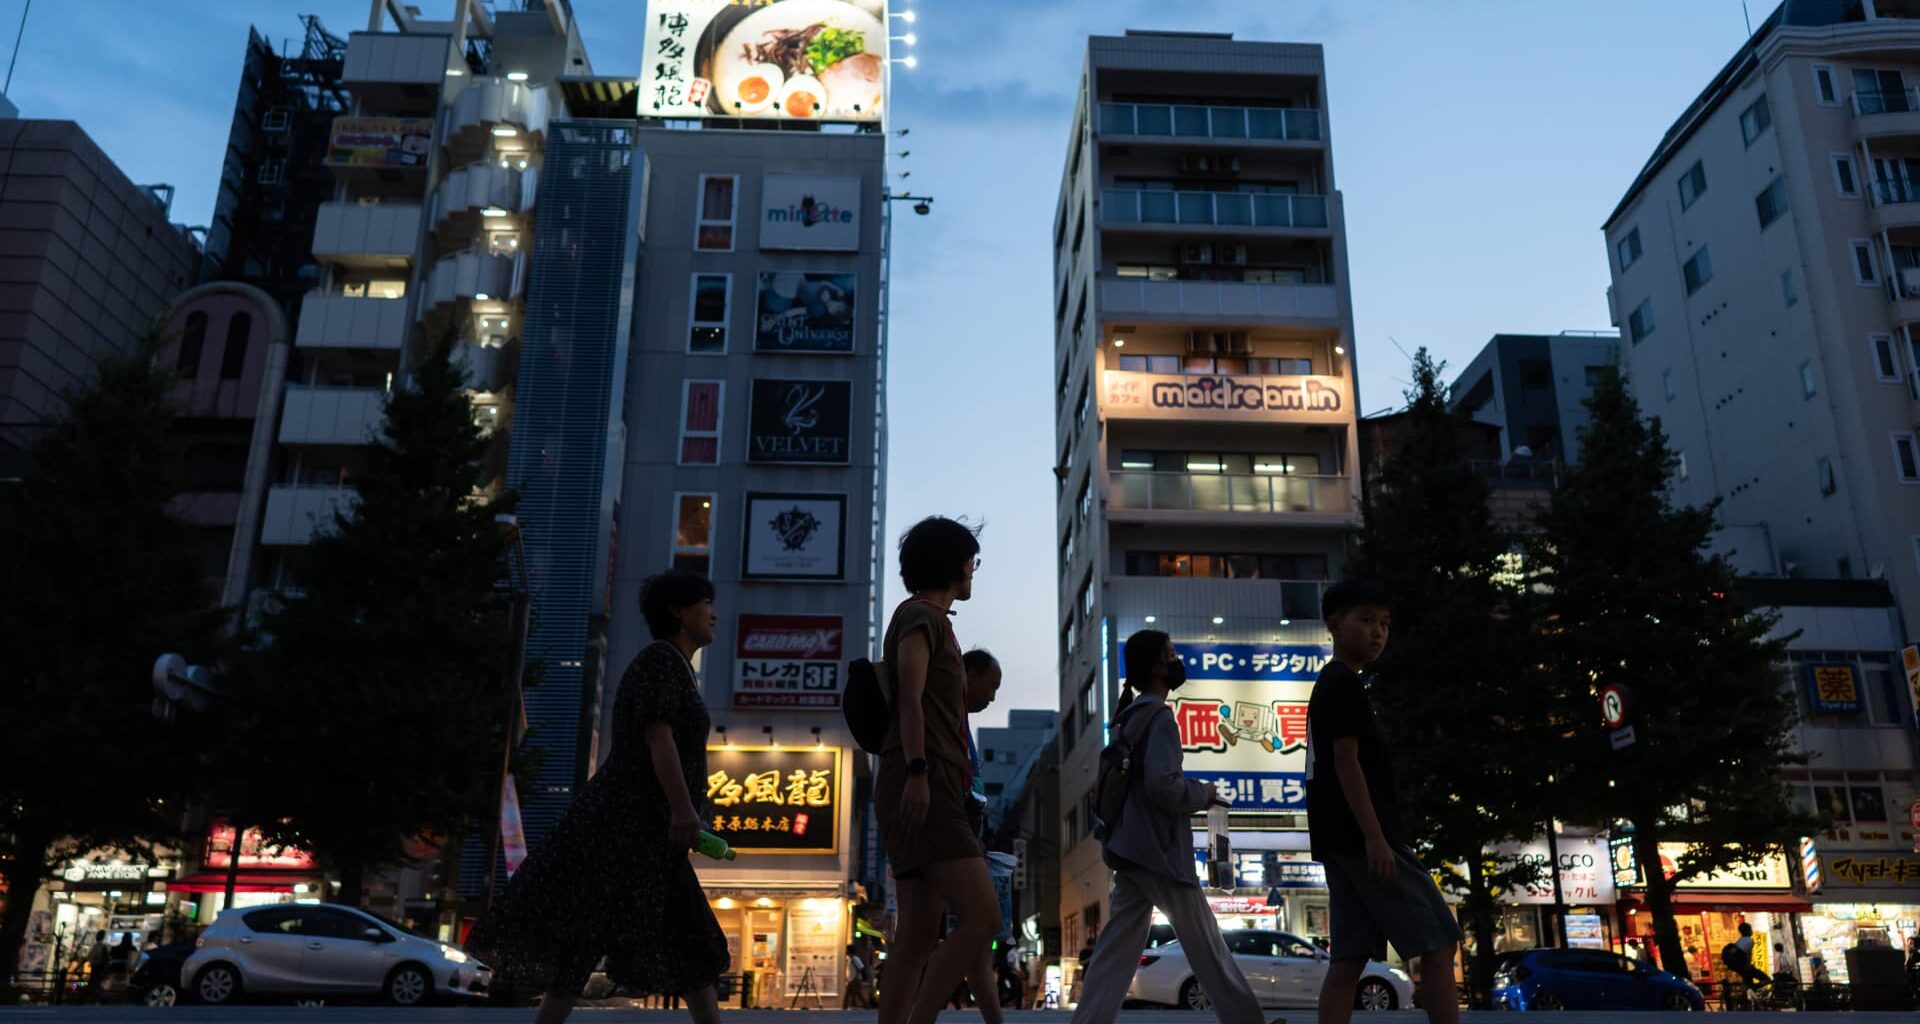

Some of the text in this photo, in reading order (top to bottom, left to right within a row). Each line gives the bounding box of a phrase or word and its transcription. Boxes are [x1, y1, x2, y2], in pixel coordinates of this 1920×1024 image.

[1110, 382, 1139, 392] メイド
[1152, 378, 1341, 411] maidreamin
[1110, 394, 1140, 404] カフェ
[755, 436, 844, 453] VELVET
[742, 662, 837, 688] トレカ 3F
[1818, 668, 1852, 700] 薬
